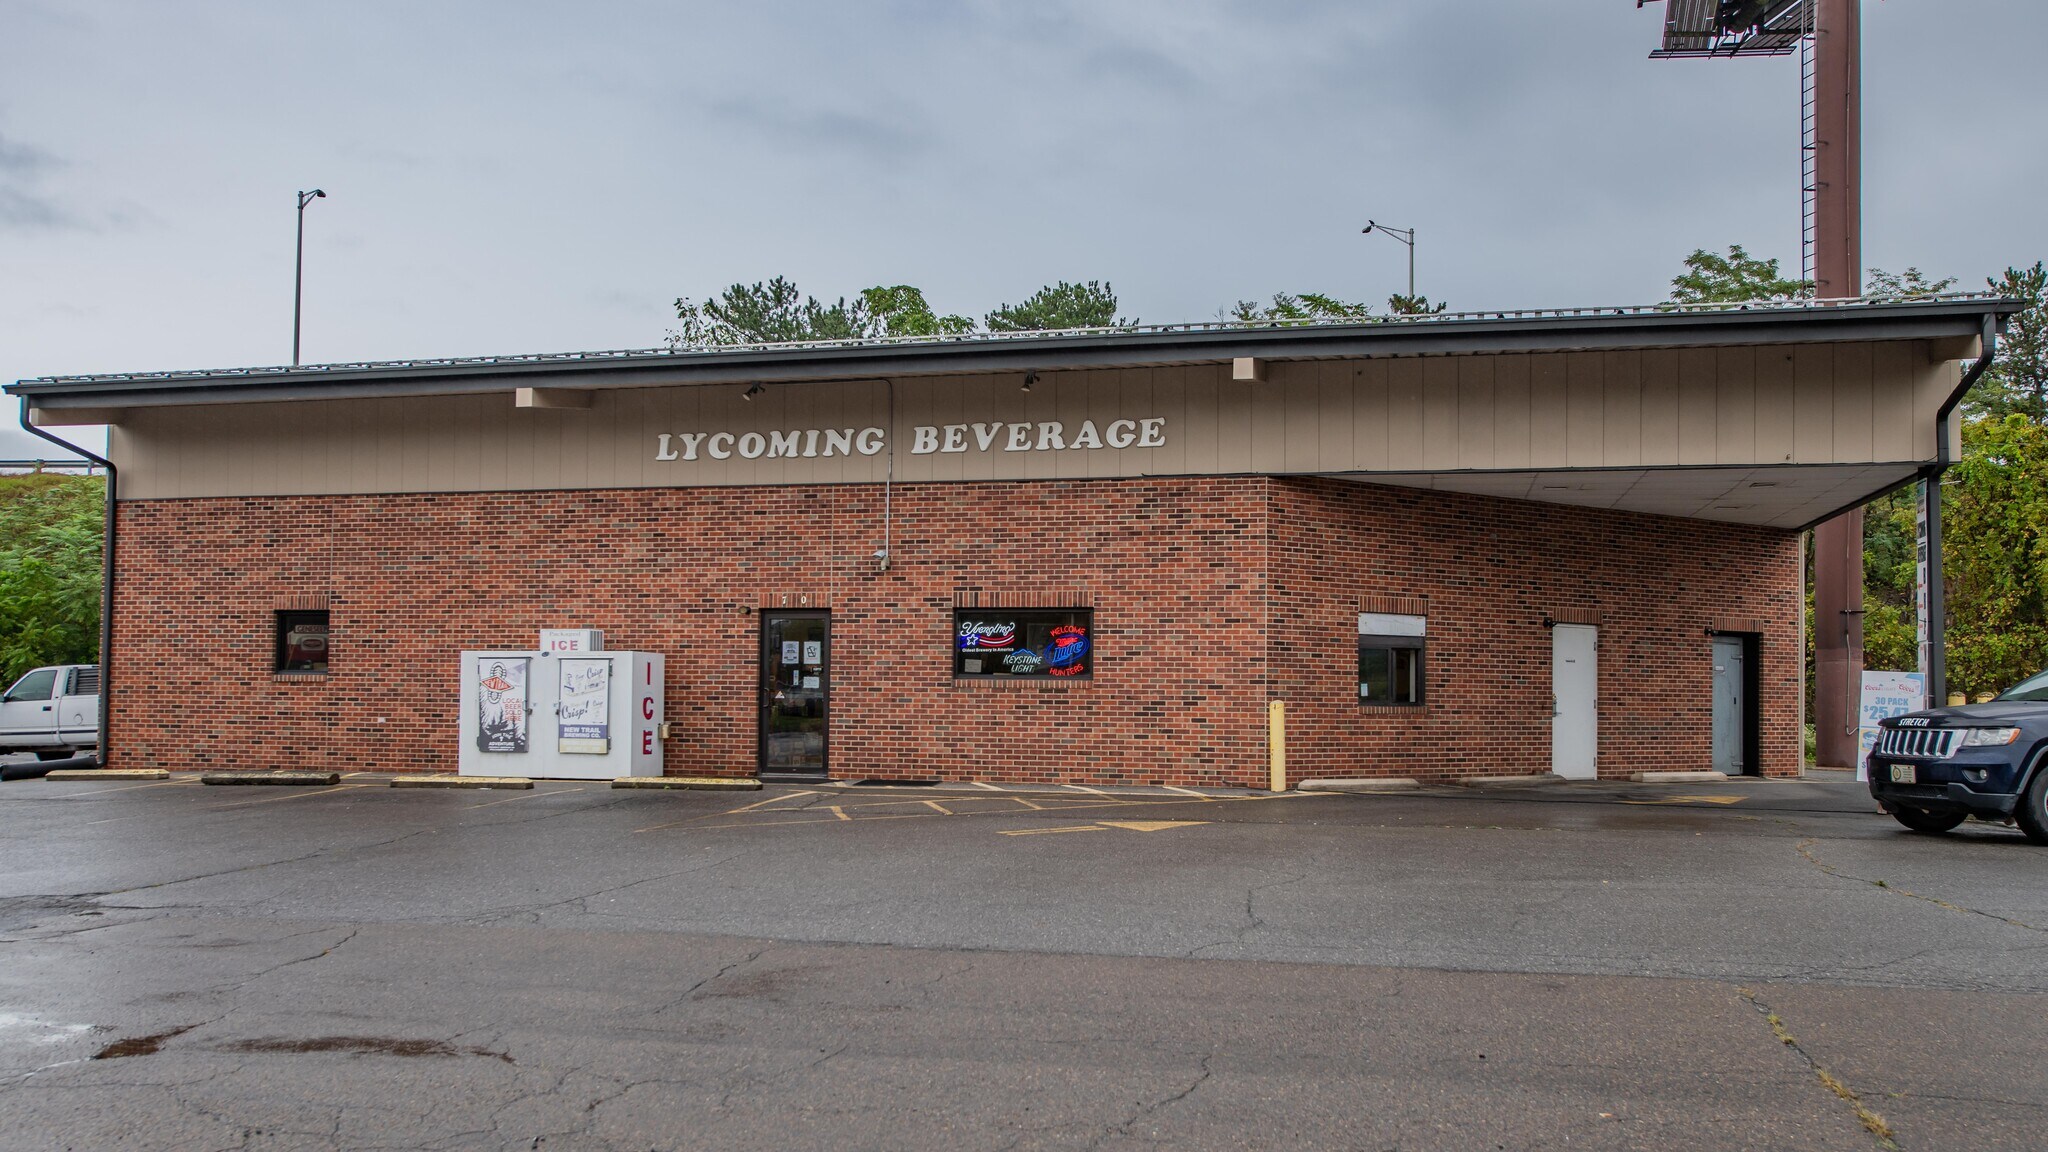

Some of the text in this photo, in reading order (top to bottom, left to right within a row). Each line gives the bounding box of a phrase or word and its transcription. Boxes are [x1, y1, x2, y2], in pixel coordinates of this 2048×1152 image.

[656, 417, 1166, 461] LYCOMING BEVERAGE
[960, 622, 1015, 636] Yuengling
[1050, 626, 1085, 636] WELCOME
[551, 640, 578, 651] ICE
[1003, 655, 1042, 664] KEYSTONE
[1011, 664, 1035, 673] LIGHT
[1049, 664, 1083, 676] HUNTERS
[1875, 696, 1909, 706] 30 PACK
[561, 700, 589, 720] Crisp!
[643, 662, 654, 755] ICE
[1864, 705, 1909, 719] $2547
[1898, 718, 1930, 727] STRETCH
